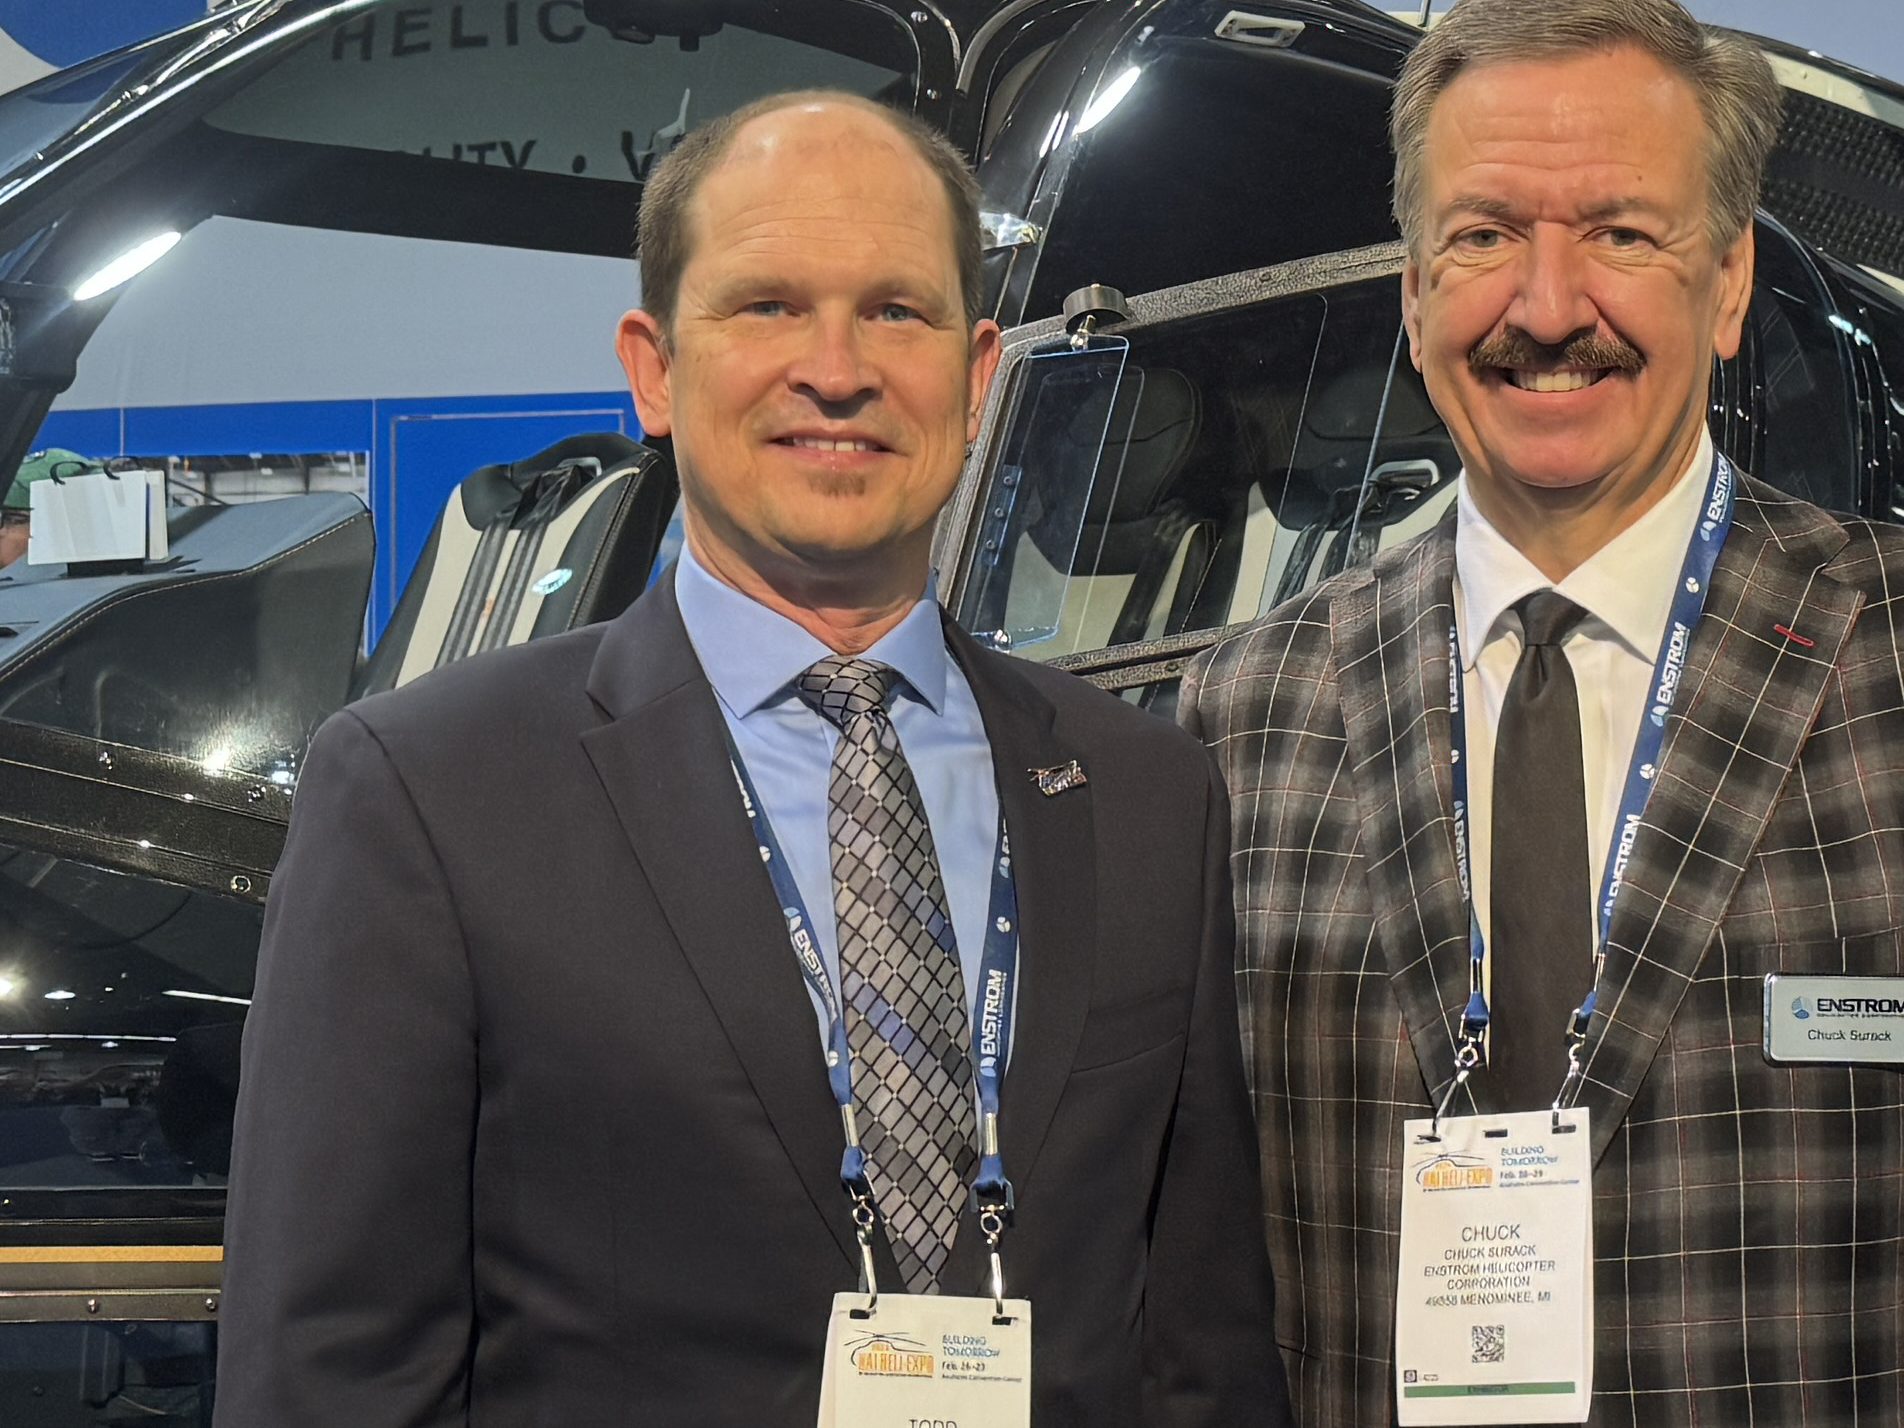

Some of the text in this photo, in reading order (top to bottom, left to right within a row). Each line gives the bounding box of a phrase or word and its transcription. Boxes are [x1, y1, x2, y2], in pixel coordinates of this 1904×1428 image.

[1657, 622, 1689, 705] ENSTROM
[981, 969, 1001, 1056] ENSTROM
[1807, 1029, 1846, 1041] Chuck
[1462, 1224, 1521, 1242] CHUCK
[1444, 1245, 1536, 1260] CHUCK SURACK
[1447, 1276, 1530, 1290] CORPORATION
